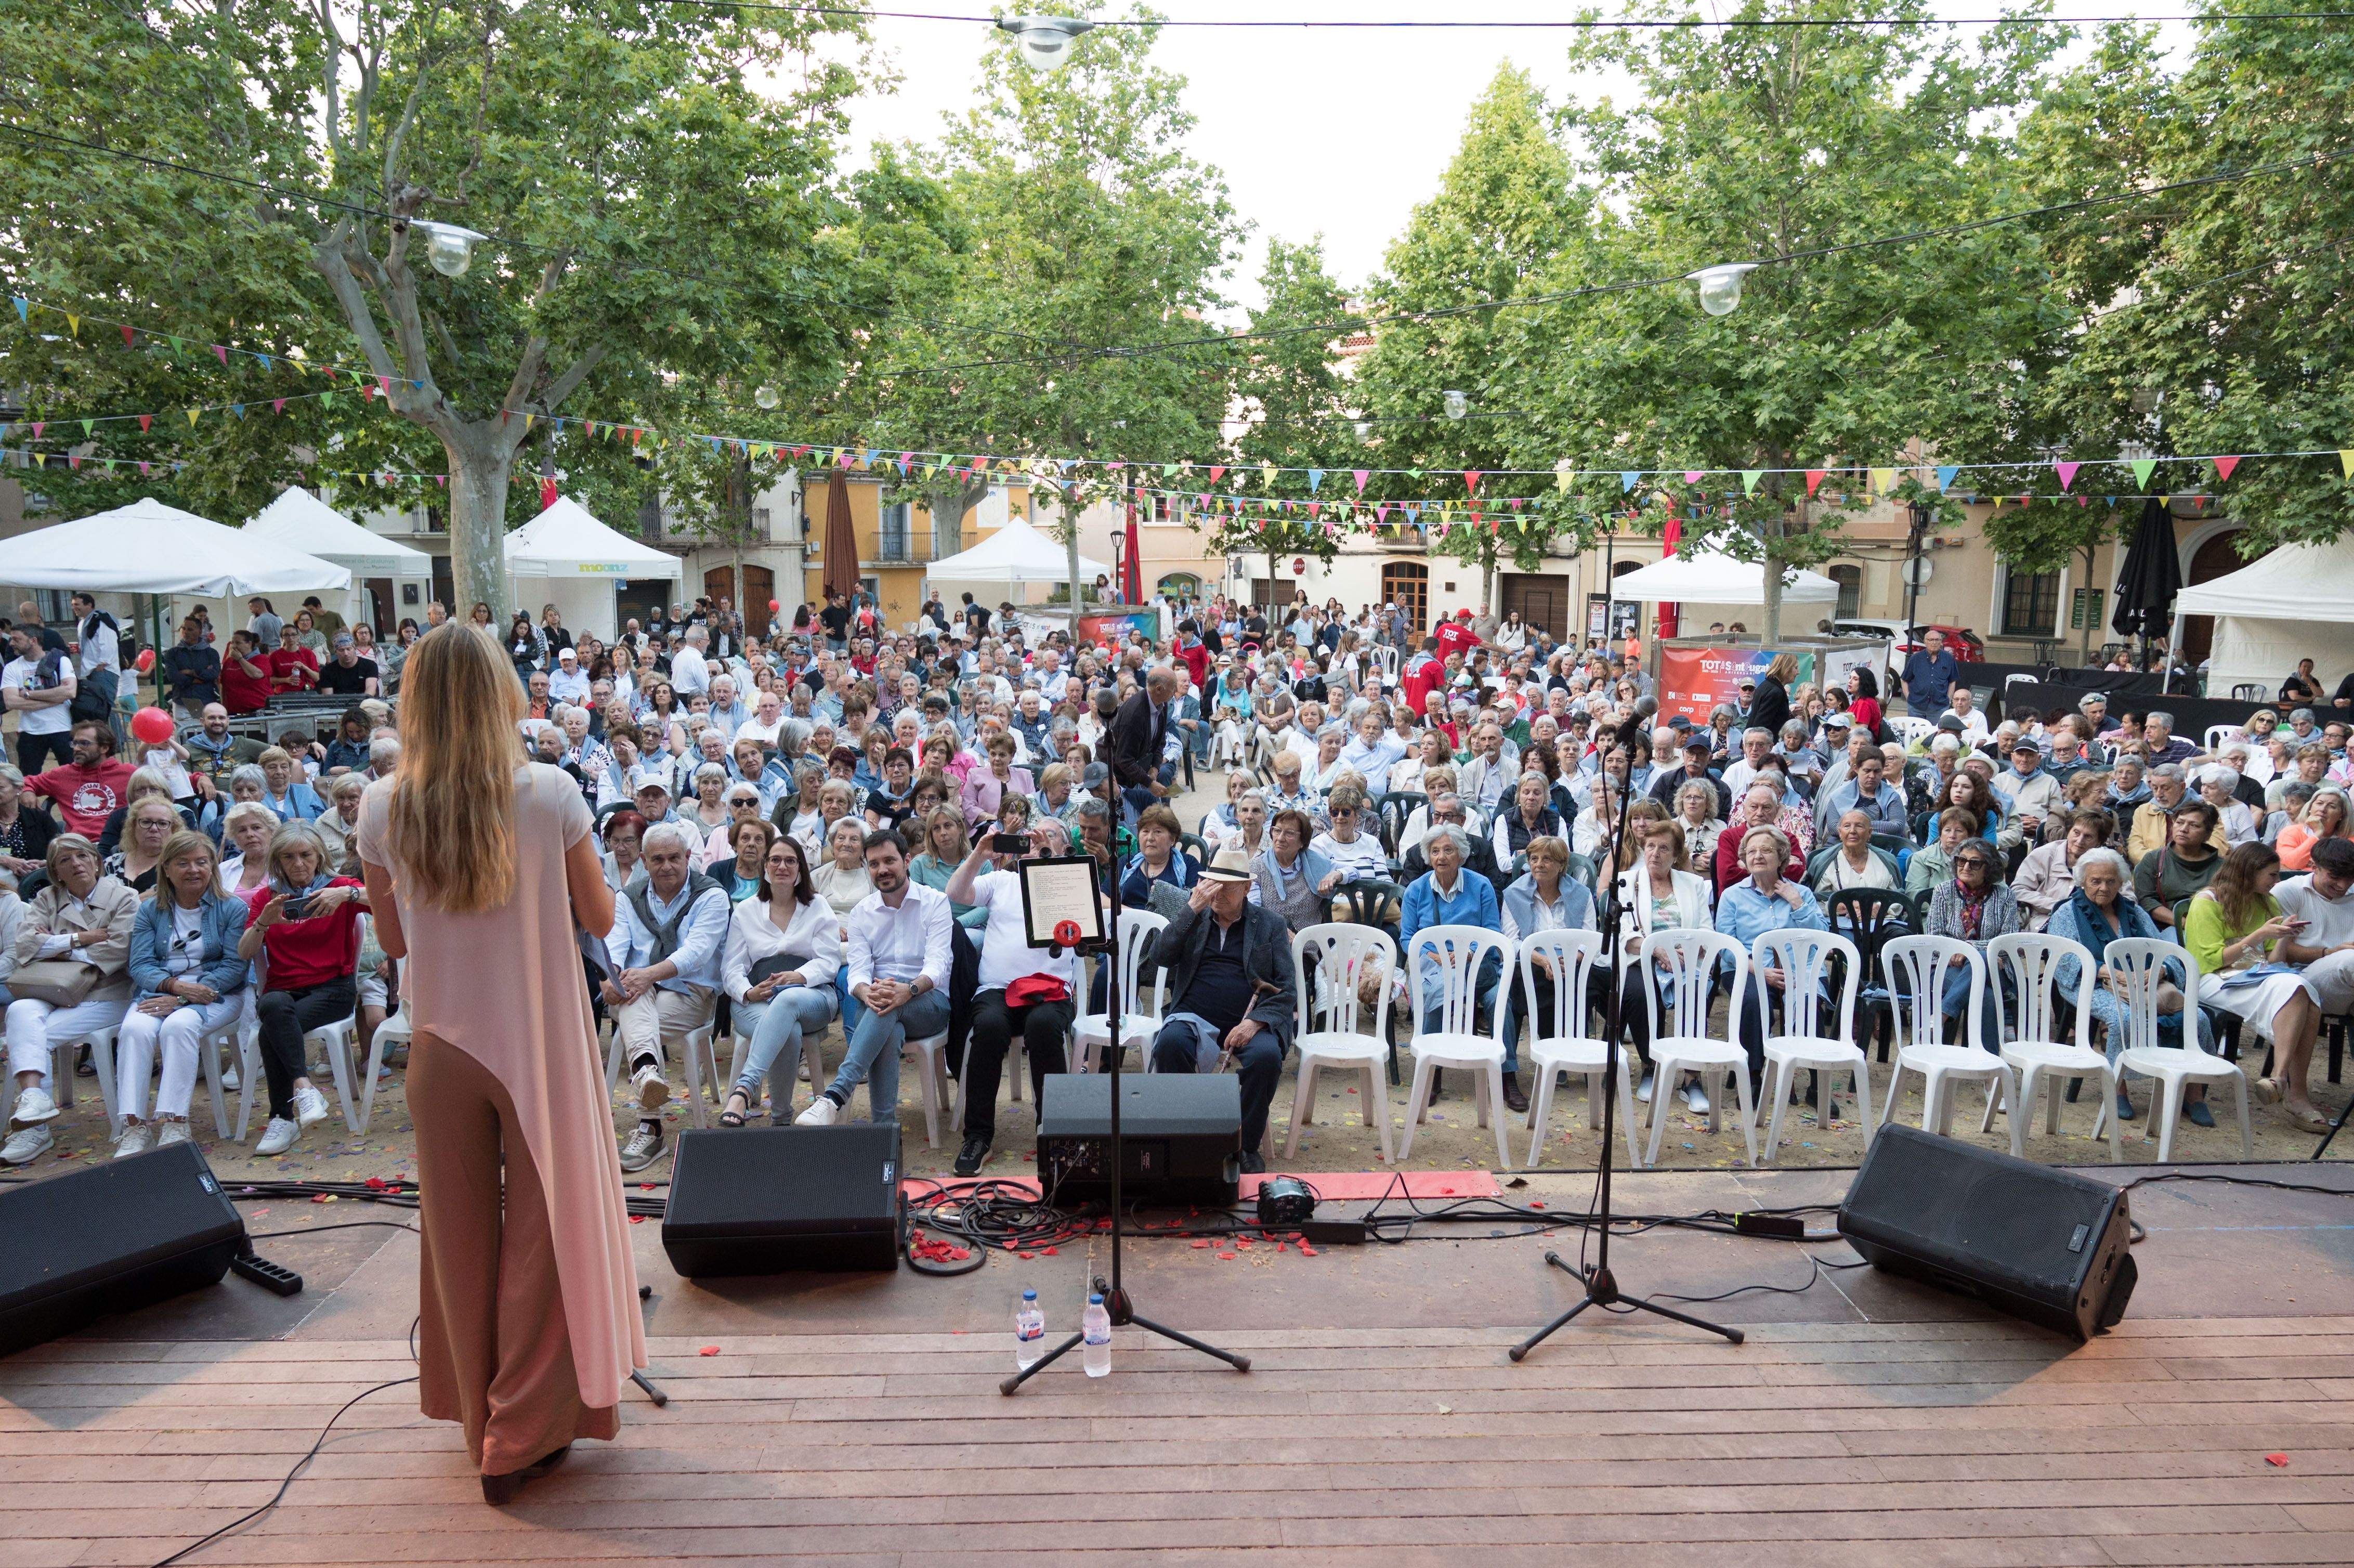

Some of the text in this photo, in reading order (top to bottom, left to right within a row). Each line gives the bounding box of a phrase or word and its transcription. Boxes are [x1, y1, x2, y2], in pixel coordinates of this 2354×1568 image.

[1444, 629, 1459, 637] TOT
[1700, 660, 1721, 670] TOT
[200, 1176, 213, 1192] QSC
